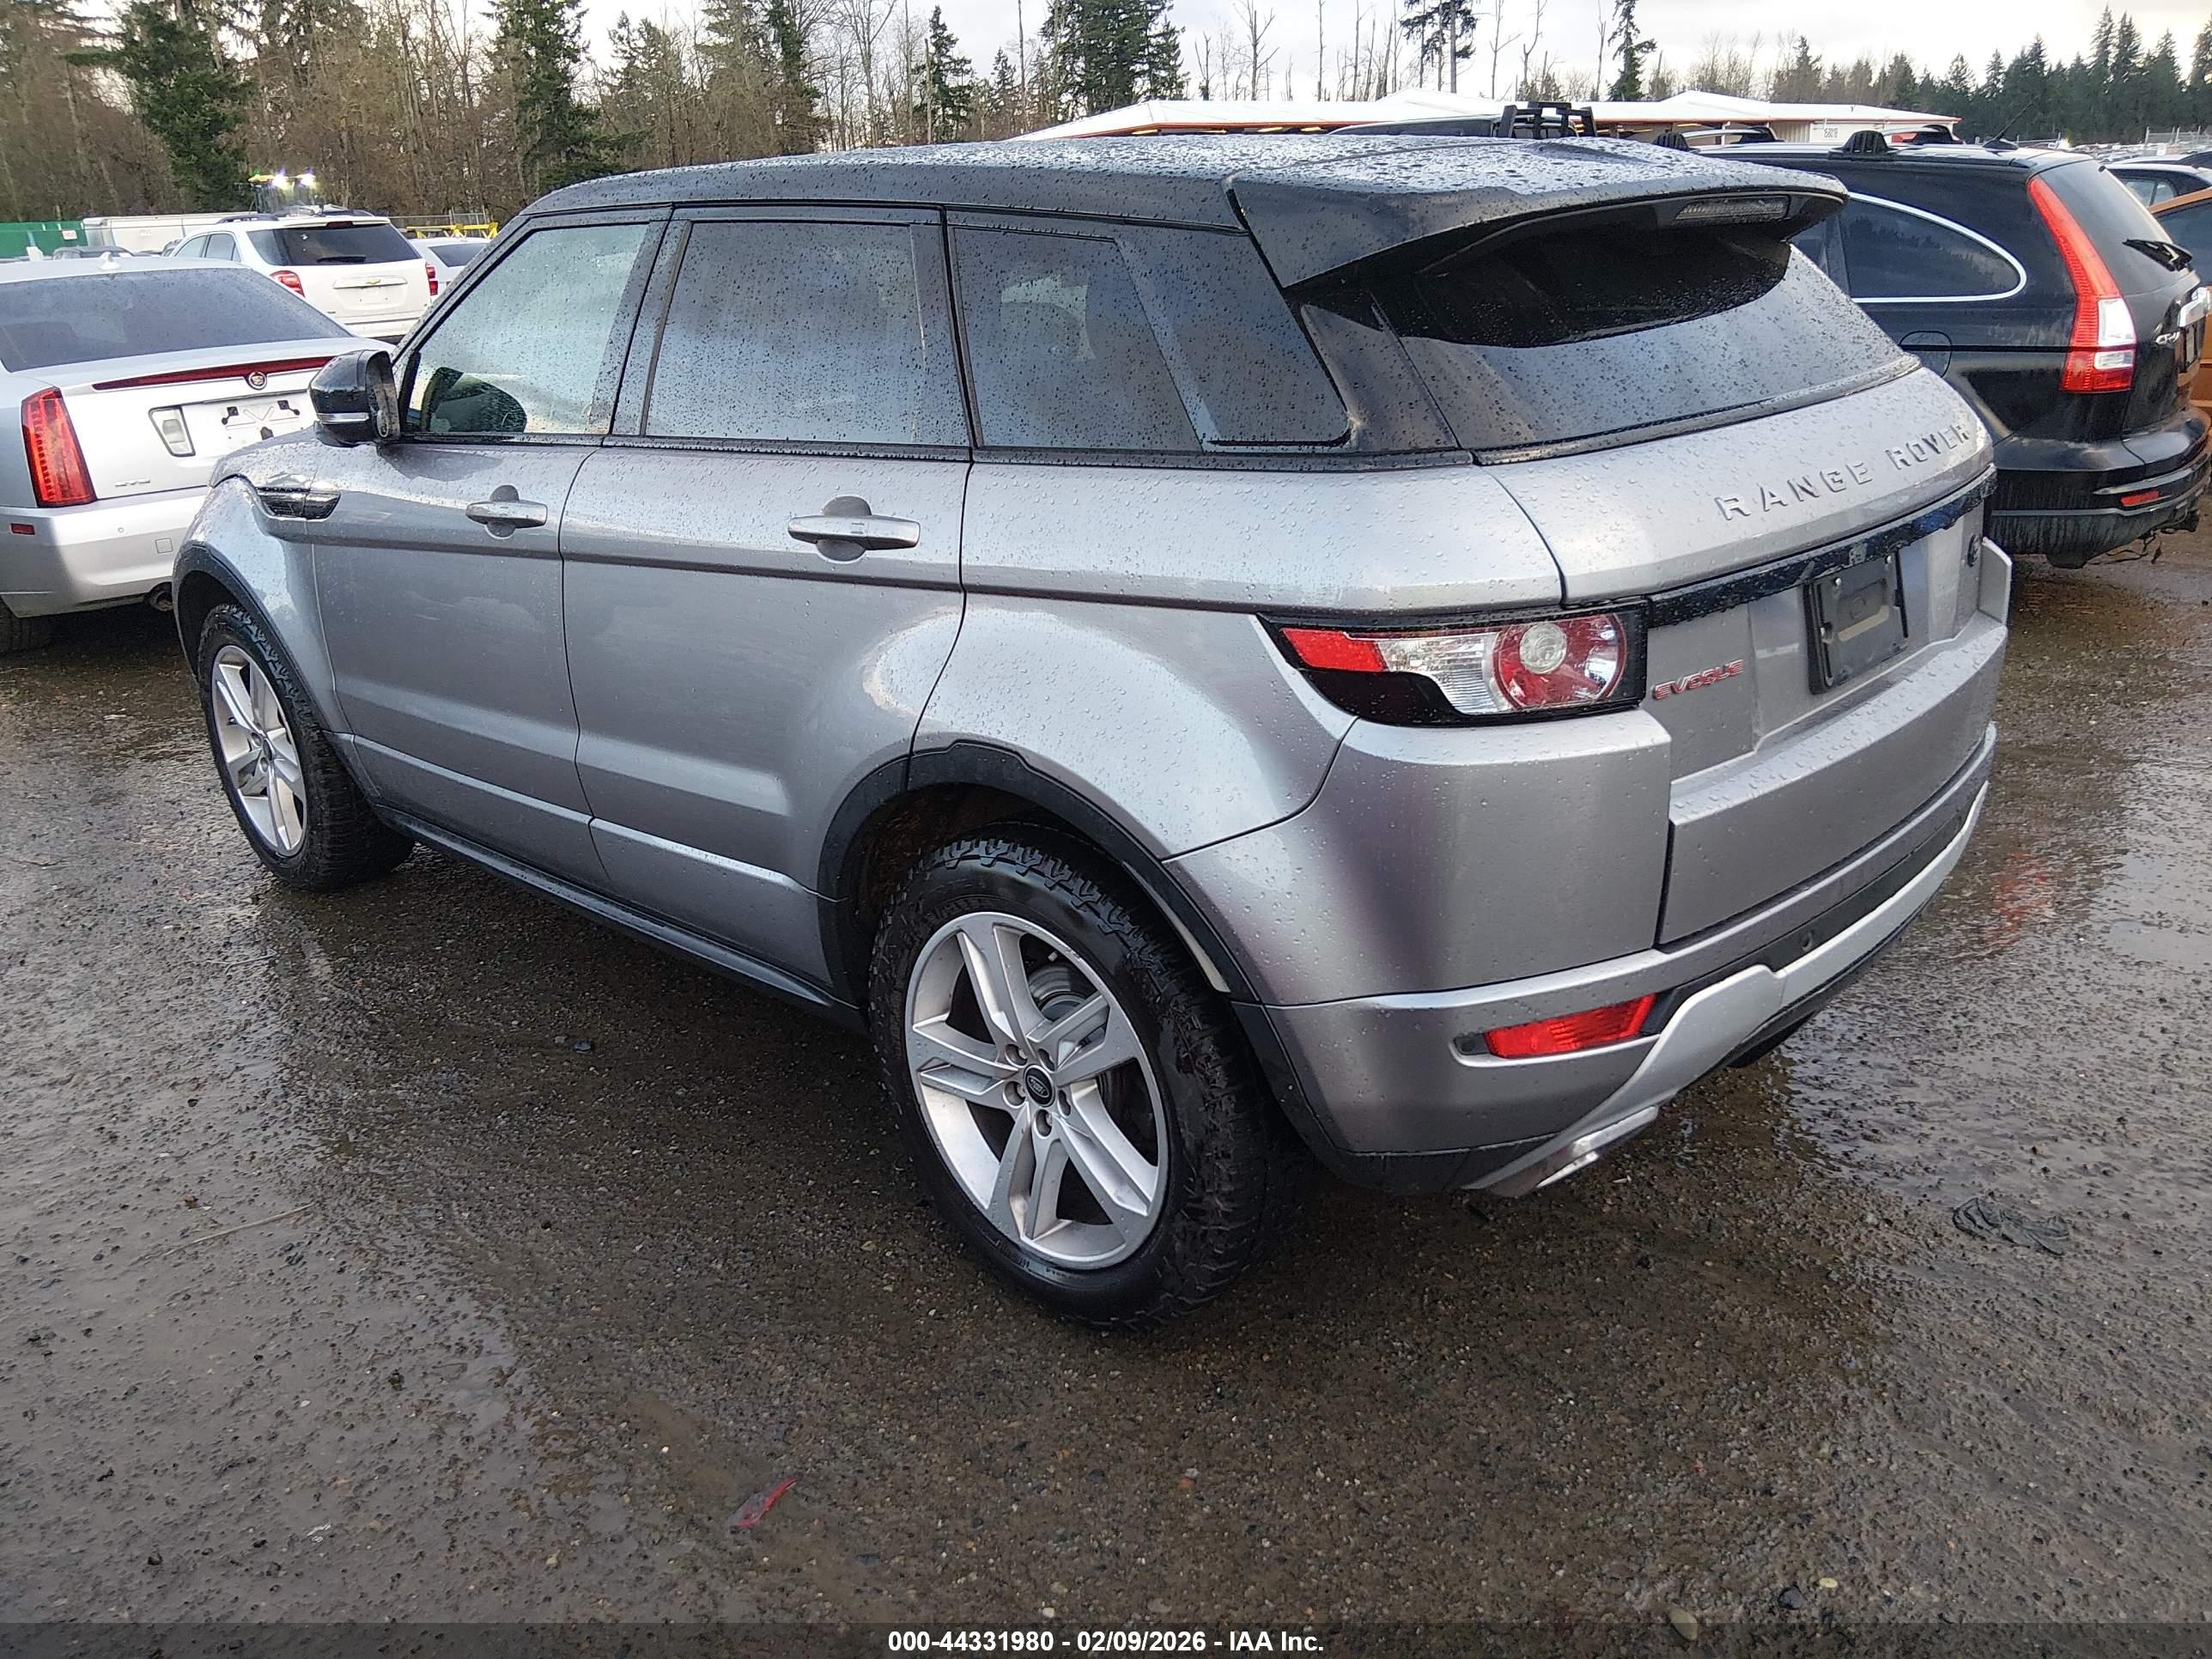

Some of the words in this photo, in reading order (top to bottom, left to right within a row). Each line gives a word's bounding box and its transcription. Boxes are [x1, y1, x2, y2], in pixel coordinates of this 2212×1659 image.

[1713, 461, 1873, 521] RANGE
[1884, 423, 1971, 471] ROVER
[1651, 659, 1746, 700] EVOQUE
